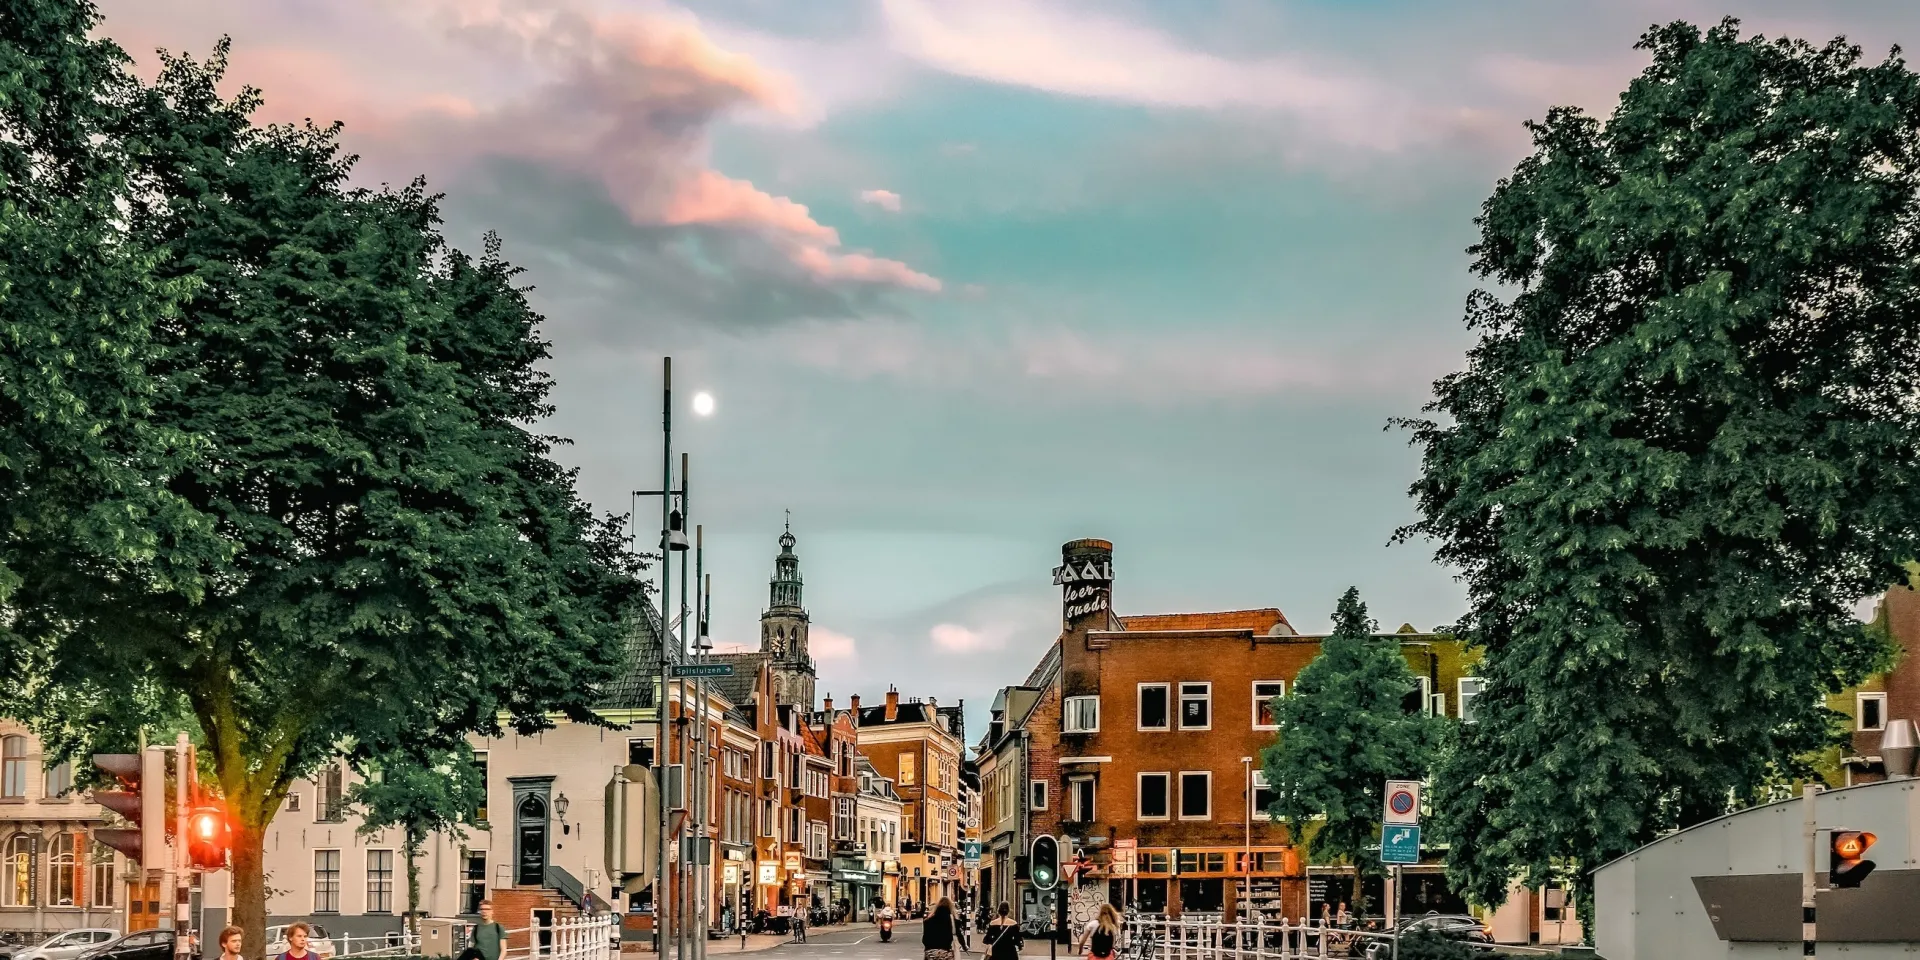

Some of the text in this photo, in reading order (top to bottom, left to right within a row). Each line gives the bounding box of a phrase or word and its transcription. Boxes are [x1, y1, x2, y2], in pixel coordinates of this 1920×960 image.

[1064, 585, 1101, 602] leer-
[1067, 596, 1107, 618] suede
[676, 667, 722, 676] Spilsluizen
